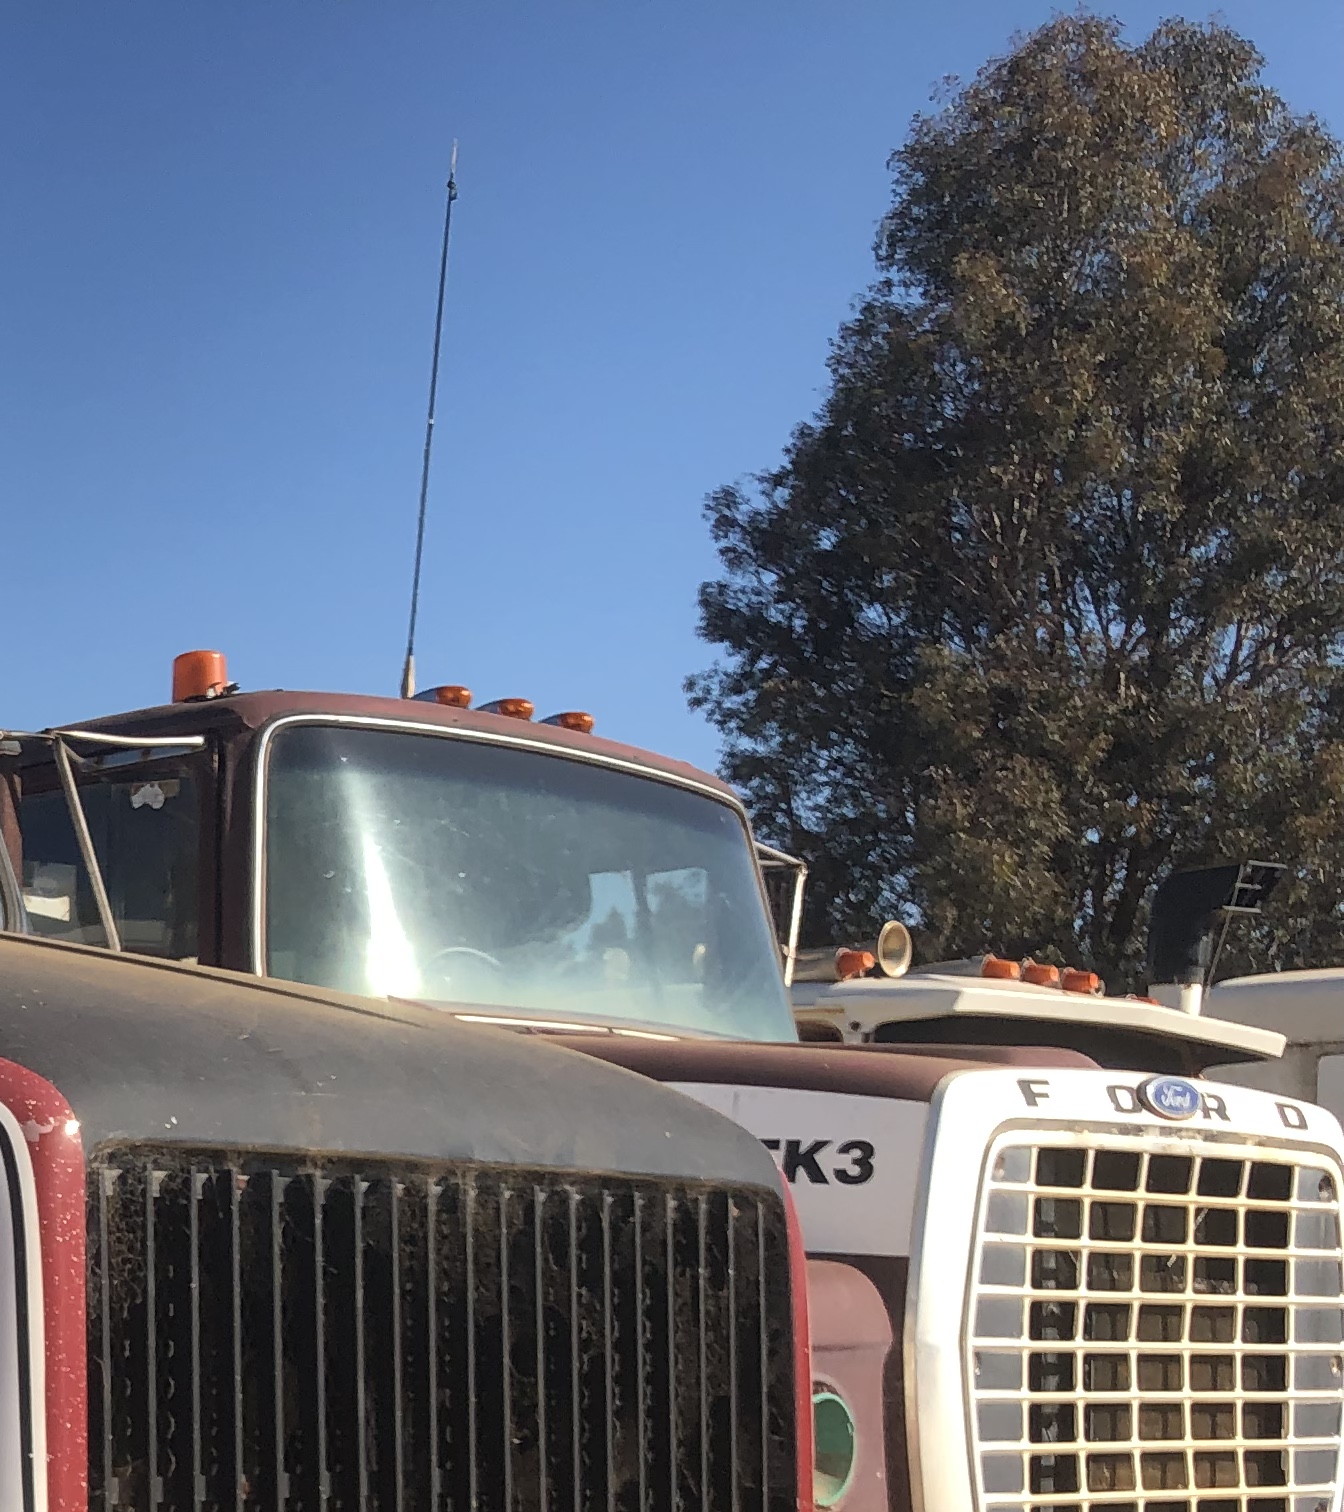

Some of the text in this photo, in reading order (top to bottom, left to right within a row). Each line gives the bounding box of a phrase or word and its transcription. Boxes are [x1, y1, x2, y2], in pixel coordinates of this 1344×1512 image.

[1016, 1079, 1308, 1131] FORD
[1161, 1085, 1191, 1107] Ford
[760, 1138, 875, 1185] K3
